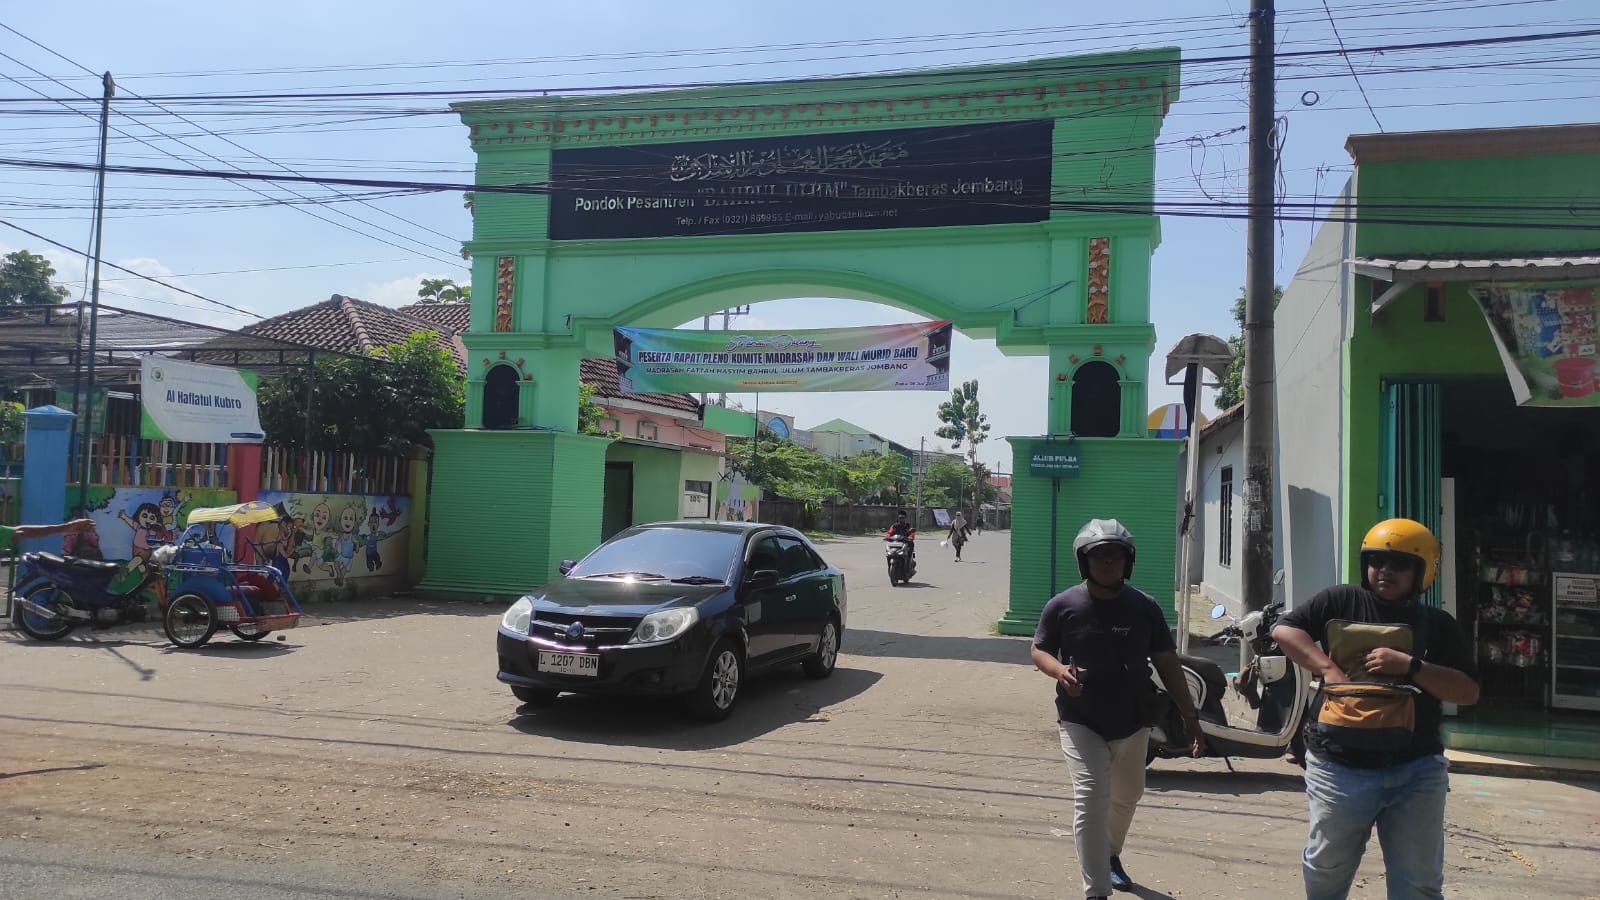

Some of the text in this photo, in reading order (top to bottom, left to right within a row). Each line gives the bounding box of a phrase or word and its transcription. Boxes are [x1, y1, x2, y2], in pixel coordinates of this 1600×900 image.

[575, 196, 624, 211] Pondok
[627, 193, 695, 209] Pesantren
[851, 181, 948, 198] Tambakberas
[676, 217, 696, 226] Telp.
[704, 216, 719, 225] Fax
[722, 214, 748, 225] (0321)
[638, 346, 919, 364] PESERTA RAPAT PLENO KOMITE MADRASAH DAN WALI MURID BARU
[806, 365, 865, 374] TAMBAKBERAS
[867, 363, 908, 371] JOMBANG
[166, 390, 175, 403] Al
[214, 395, 241, 409] Kubro
[540, 654, 597, 669] L 1207 DBN
